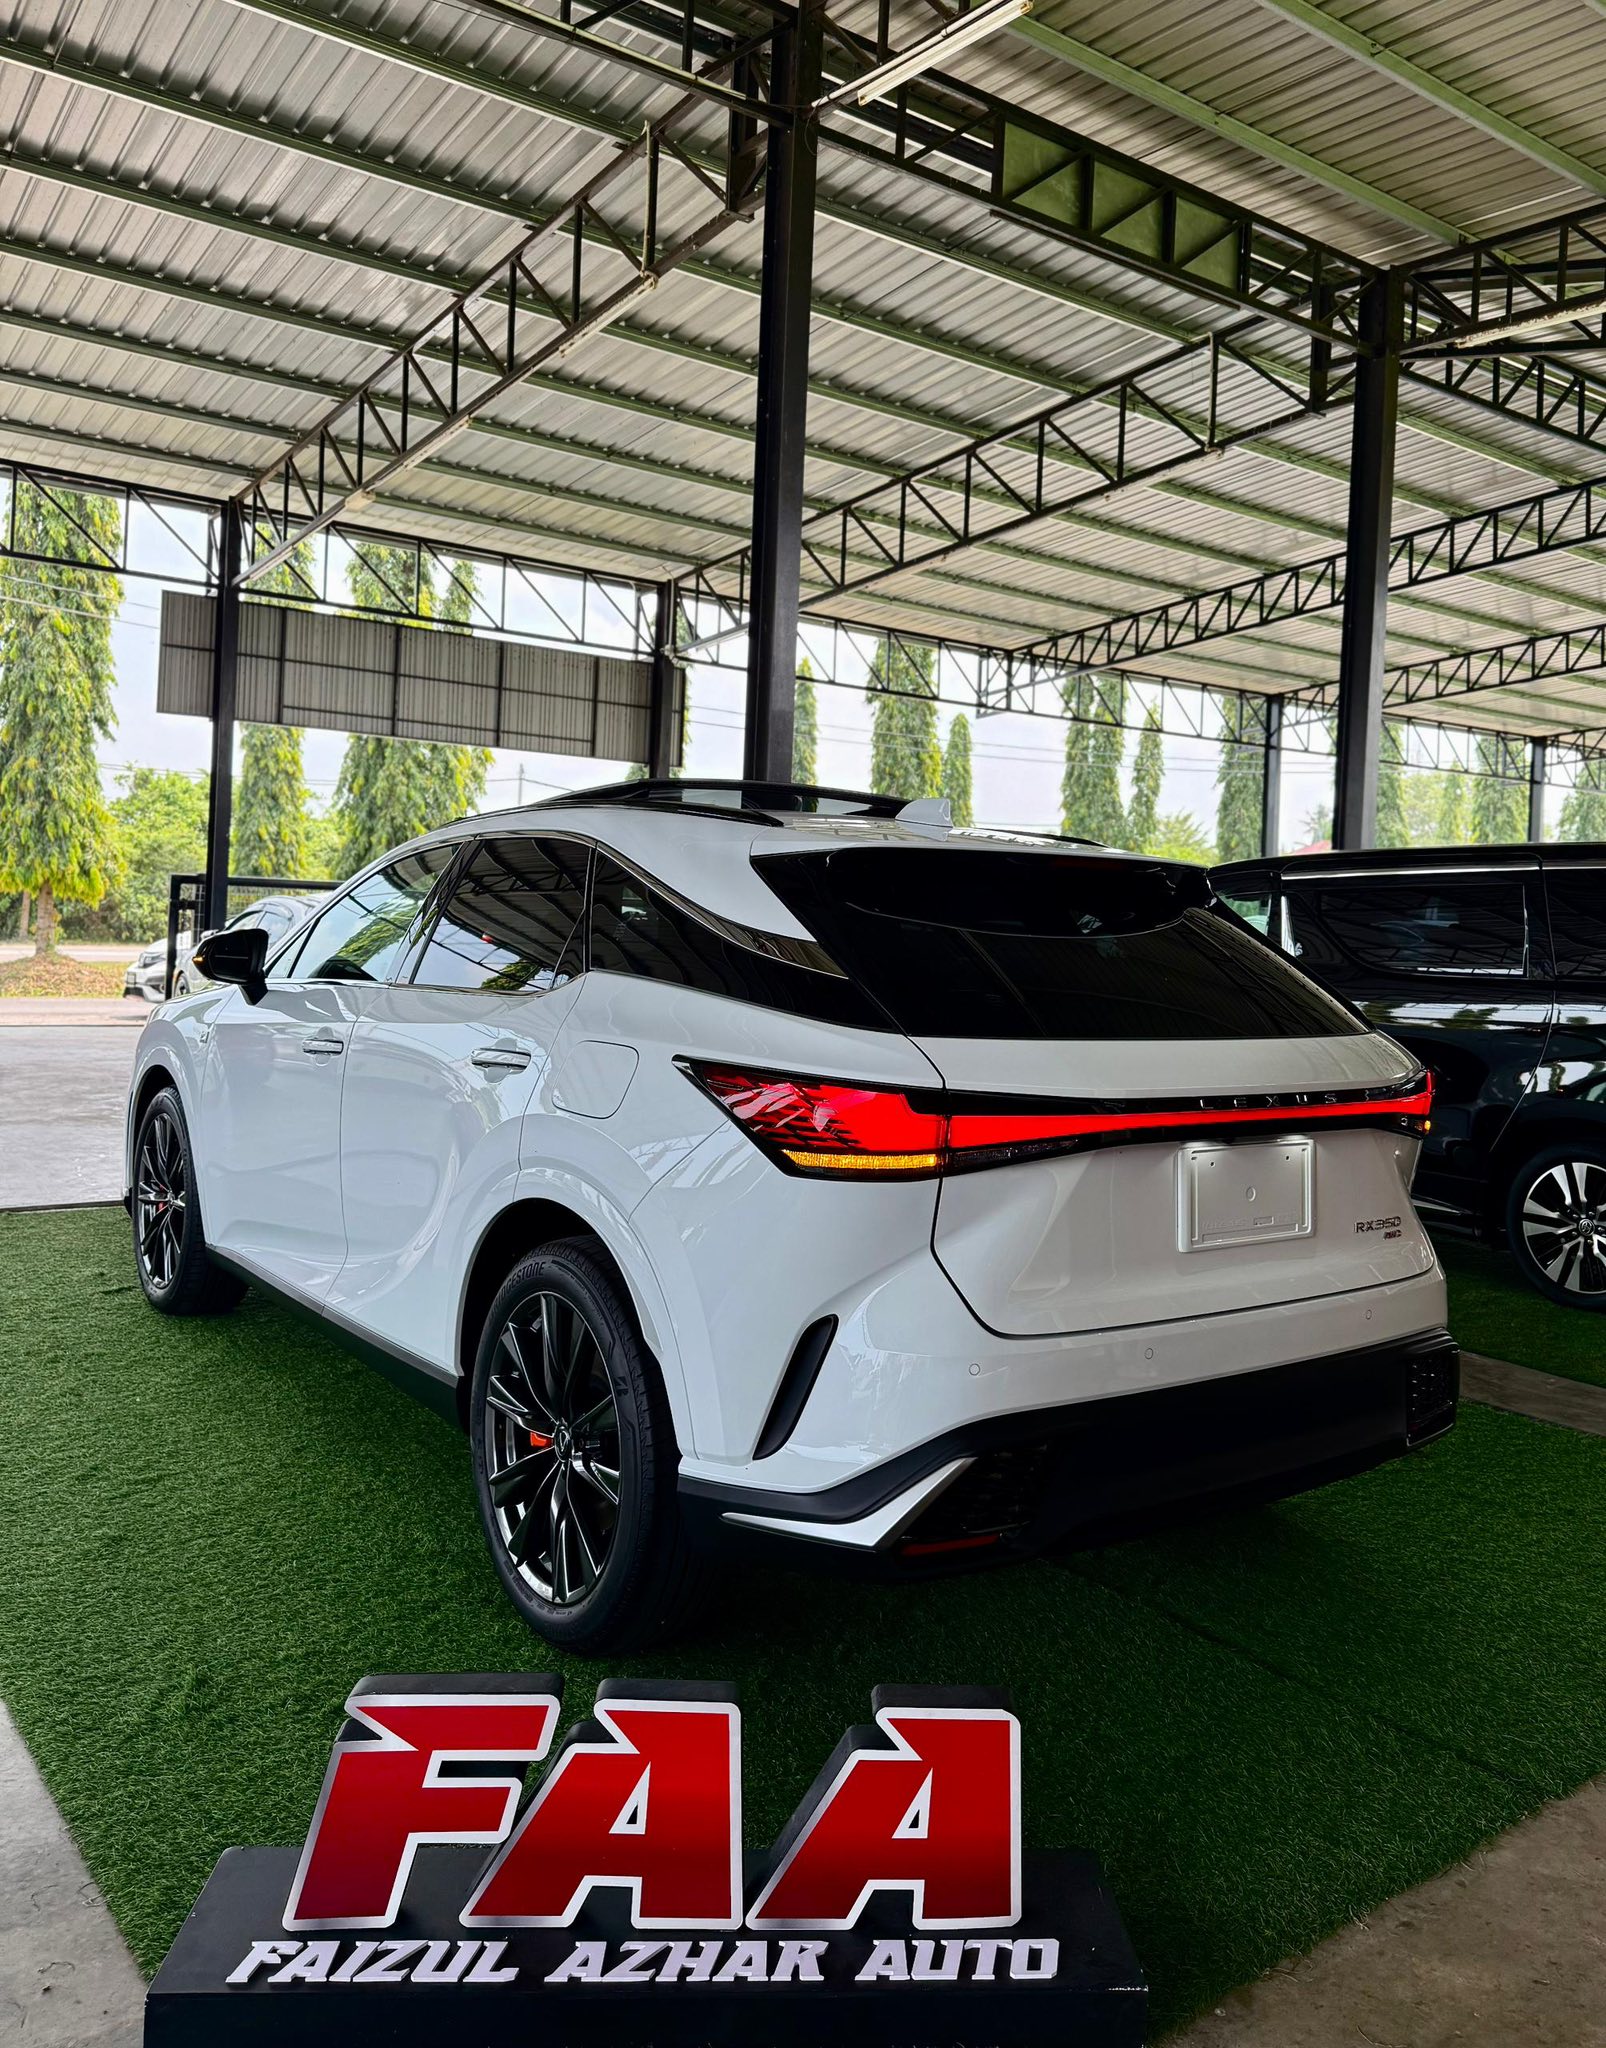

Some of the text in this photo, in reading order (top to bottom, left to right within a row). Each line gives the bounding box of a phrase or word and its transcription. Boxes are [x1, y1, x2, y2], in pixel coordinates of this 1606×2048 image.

[1200, 1093, 1338, 1110] LEXUS
[1354, 1216, 1402, 1233] RX350
[281, 1693, 1022, 1931] FAA
[225, 1938, 1060, 1983] FAIZUL AZHAR AUTO
